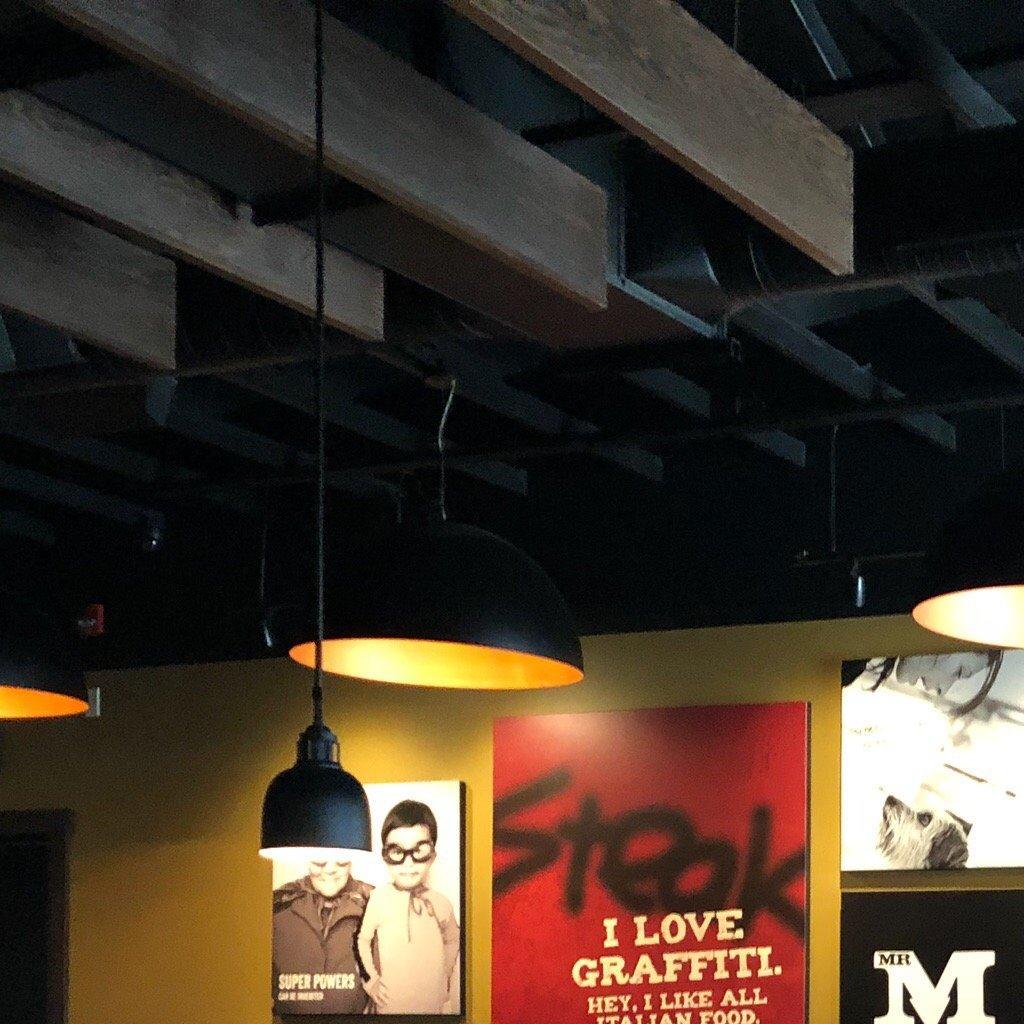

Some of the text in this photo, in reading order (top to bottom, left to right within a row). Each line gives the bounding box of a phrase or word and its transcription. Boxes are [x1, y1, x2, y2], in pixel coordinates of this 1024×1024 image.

[603, 917, 619, 948] I
[571, 945, 783, 988] GRAFFITI.
[878, 953, 911, 966] MR
[278, 973, 355, 990] SUPER POWERS
[643, 993, 652, 1010] I
[660, 990, 713, 1010] LIKE
[720, 987, 768, 1007] ALL
